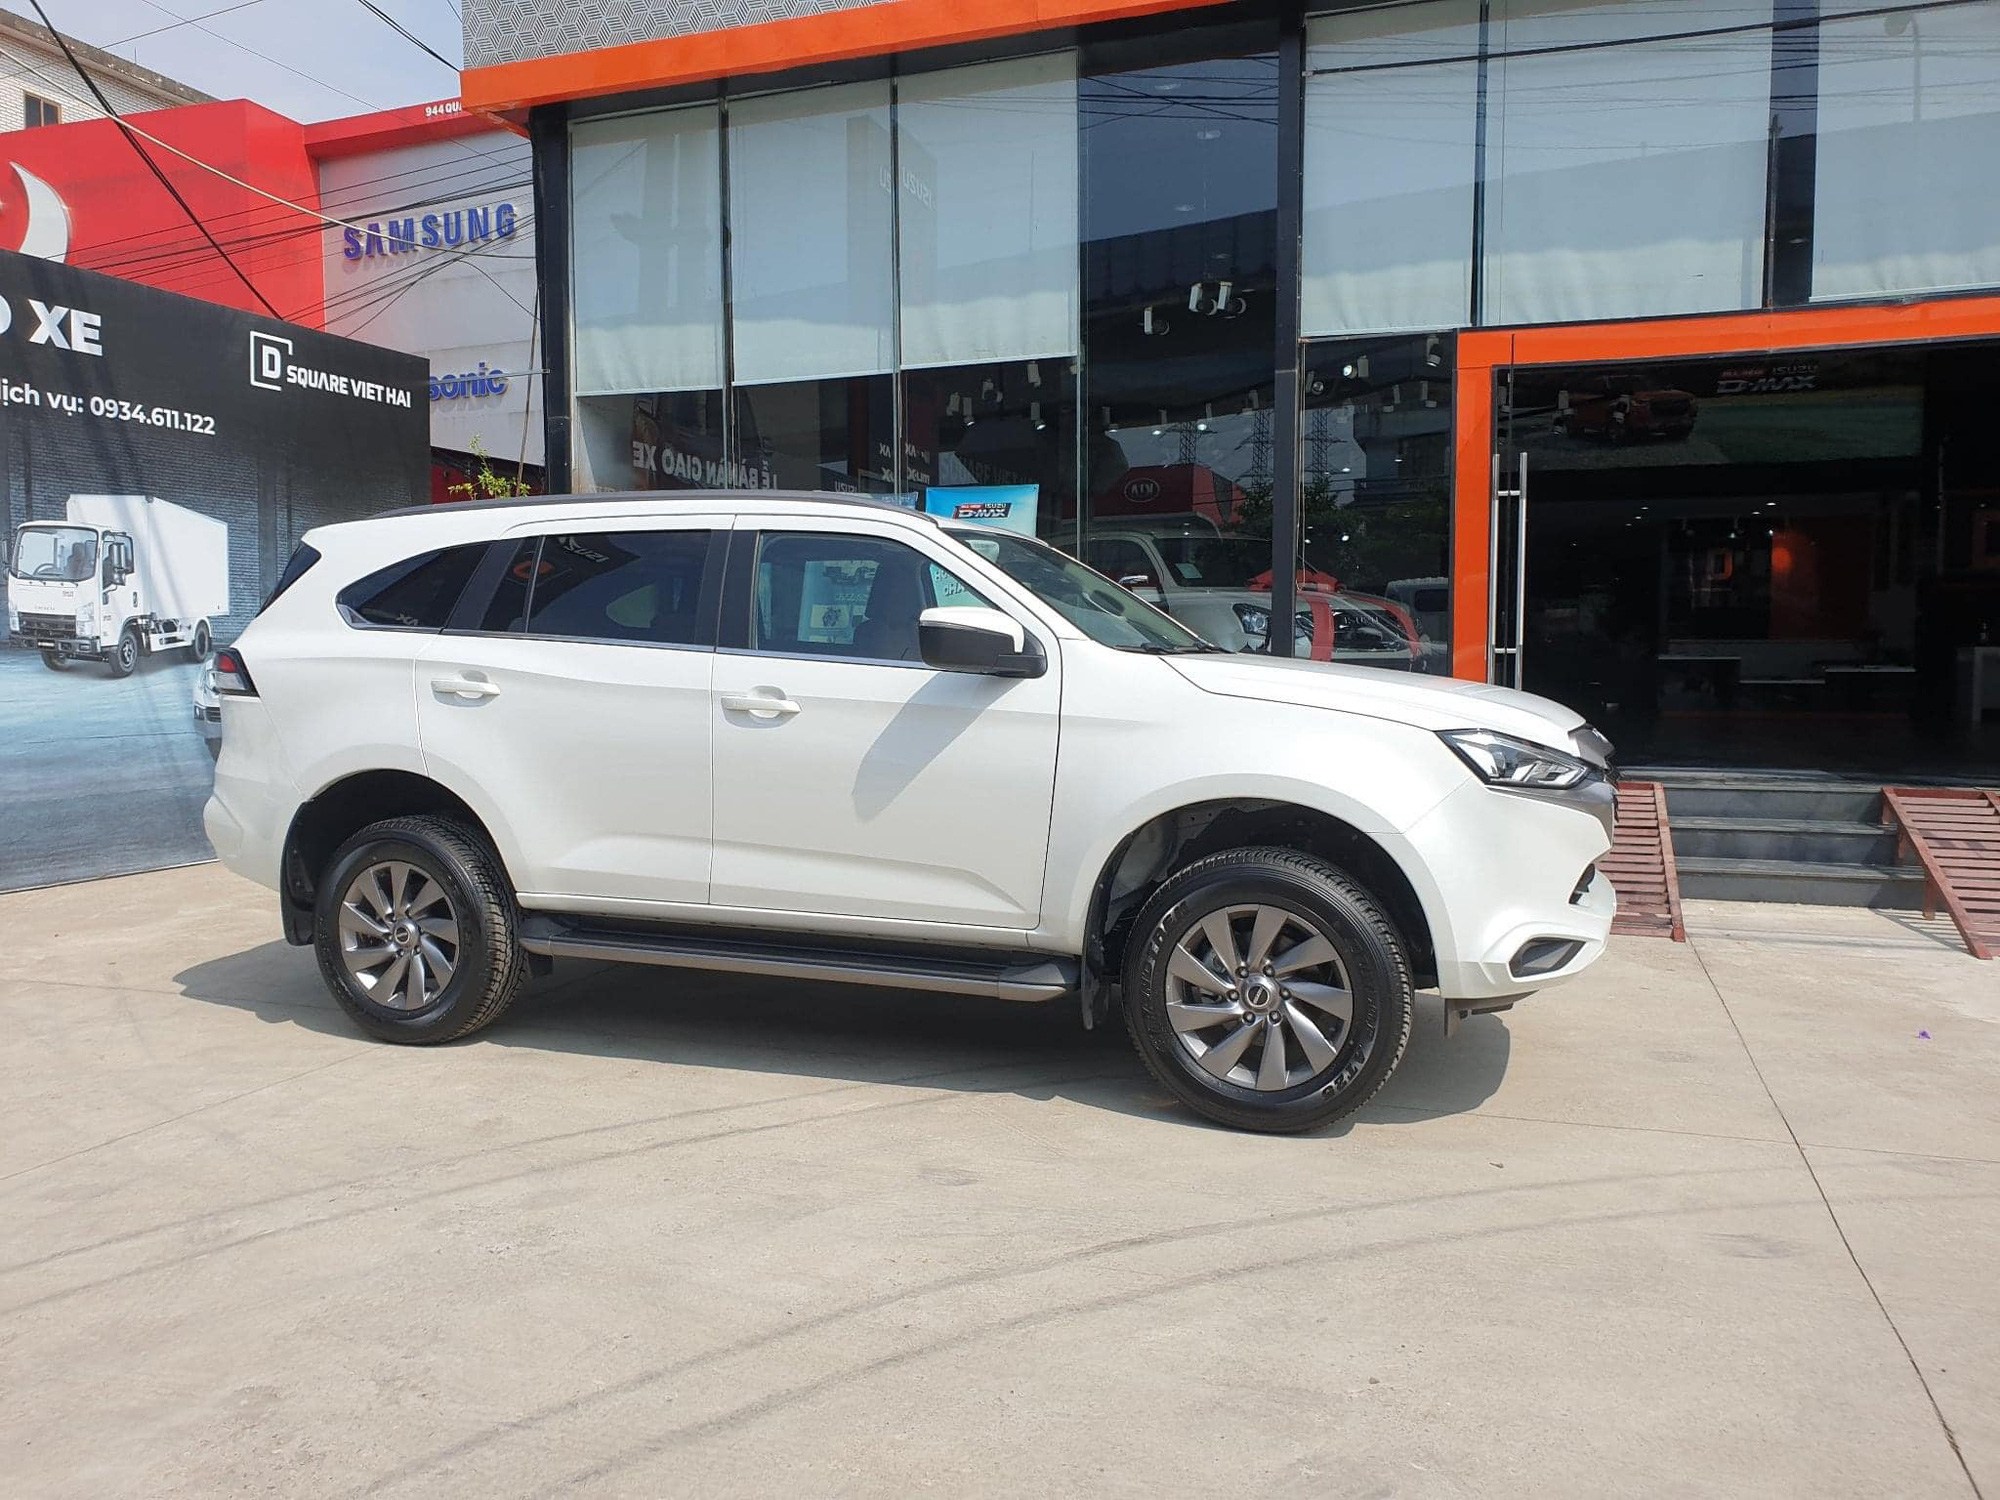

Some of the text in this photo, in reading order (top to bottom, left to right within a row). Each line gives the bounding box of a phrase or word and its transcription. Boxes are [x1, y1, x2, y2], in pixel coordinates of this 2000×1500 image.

[425, 104, 444, 117] 944
[343, 203, 517, 261] SAMSUNG
[28, 298, 103, 356] XE
[1717, 375, 1817, 393] D-MAX
[1772, 364, 1819, 375] ISUZU
[287, 365, 411, 409] SQUARE VIET HAI
[47, 391, 84, 416] vụ:
[90, 396, 216, 435] 0934.611.122
[958, 509, 1006, 518] D-MAX
